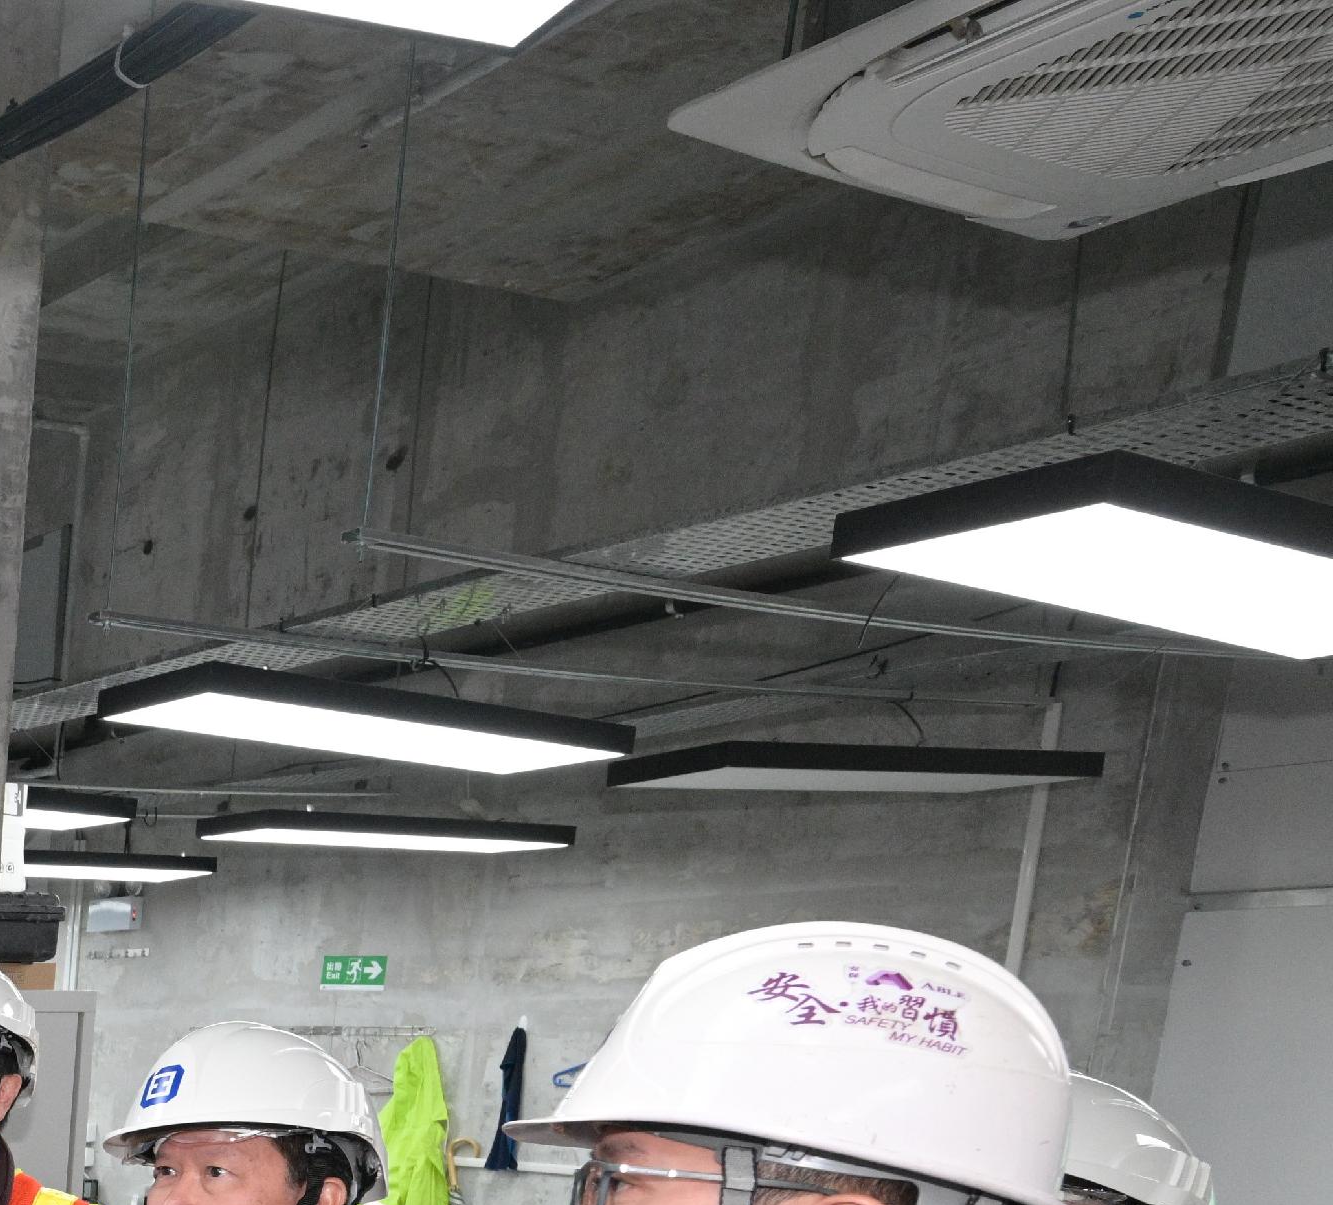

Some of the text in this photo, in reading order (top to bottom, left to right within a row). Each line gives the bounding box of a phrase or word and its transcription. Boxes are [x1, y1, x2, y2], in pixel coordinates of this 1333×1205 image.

[922, 982, 965, 1000] ABLE
[845, 1014, 913, 1030] SAFETY
[889, 1031, 969, 1056] MY HABIT
